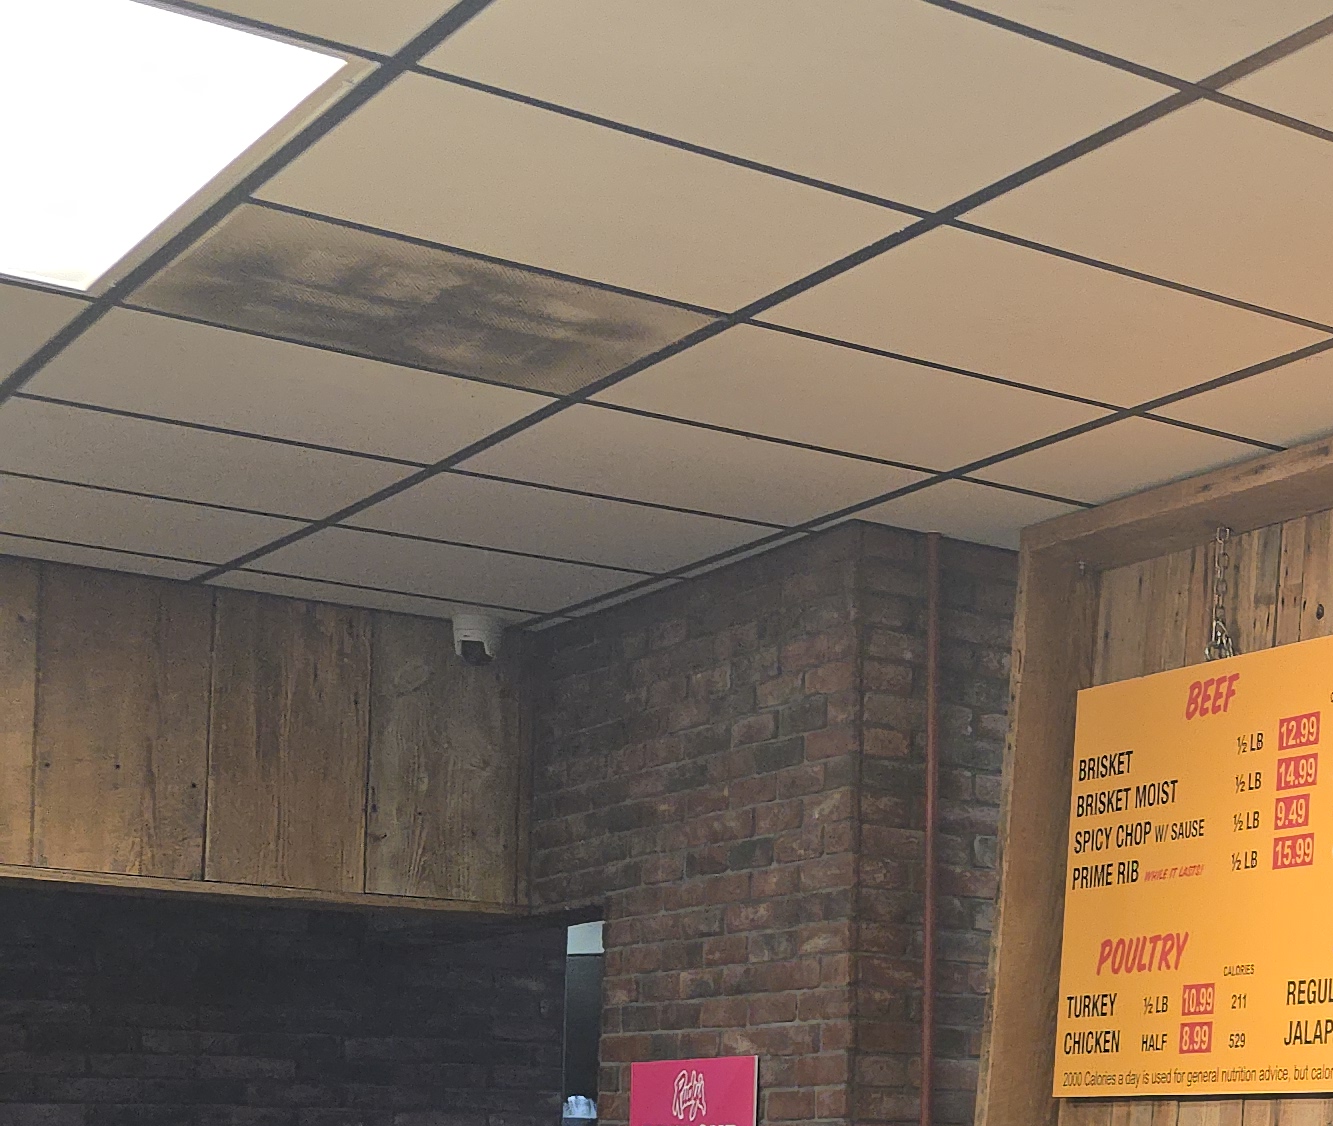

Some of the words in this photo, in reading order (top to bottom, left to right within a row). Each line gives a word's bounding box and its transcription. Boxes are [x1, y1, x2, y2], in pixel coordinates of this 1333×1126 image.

[1186, 673, 1239, 720] BEEF
[1280, 716, 1317, 747] 12.99
[1079, 751, 1133, 781] BRISKET
[1279, 757, 1315, 788] 14.99
[1076, 790, 1129, 817] BRISKET
[1135, 780, 1178, 808] MOIST
[1277, 799, 1306, 827] 9.49
[1074, 827, 1112, 854] SPICY
[1116, 821, 1151, 848] CHOP
[1155, 824, 1169, 843] W/
[1171, 819, 1205, 839] SAUSE
[1275, 838, 1313, 865] 15.99
[1072, 864, 1112, 890] PRIME
[1117, 860, 1139, 885] RIB
[1097, 932, 1188, 976] POULTRY
[1067, 993, 1117, 1018] TURKEY
[1183, 987, 1213, 1013] 10.99
[1231, 994, 1247, 1009] 211
[1064, 1030, 1120, 1055] CHICKEN
[1141, 1034, 1167, 1052] HALF
[1182, 1026, 1209, 1050] 8.99
[1228, 1034, 1245, 1048] 529
[1084, 1070, 1115, 1086] Calories
[1118, 1073, 1123, 1085] a
[1125, 1071, 1140, 1088] day
[1142, 1070, 1150, 1085] is
[1151, 1069, 1171, 1084] used
[1174, 1069, 1184, 1083] for
[1187, 1067, 1218, 1087] general
[1221, 1066, 1256, 1083] nutrition
[1259, 1065, 1291, 1082] advice,
[1294, 1065, 1308, 1080] but
